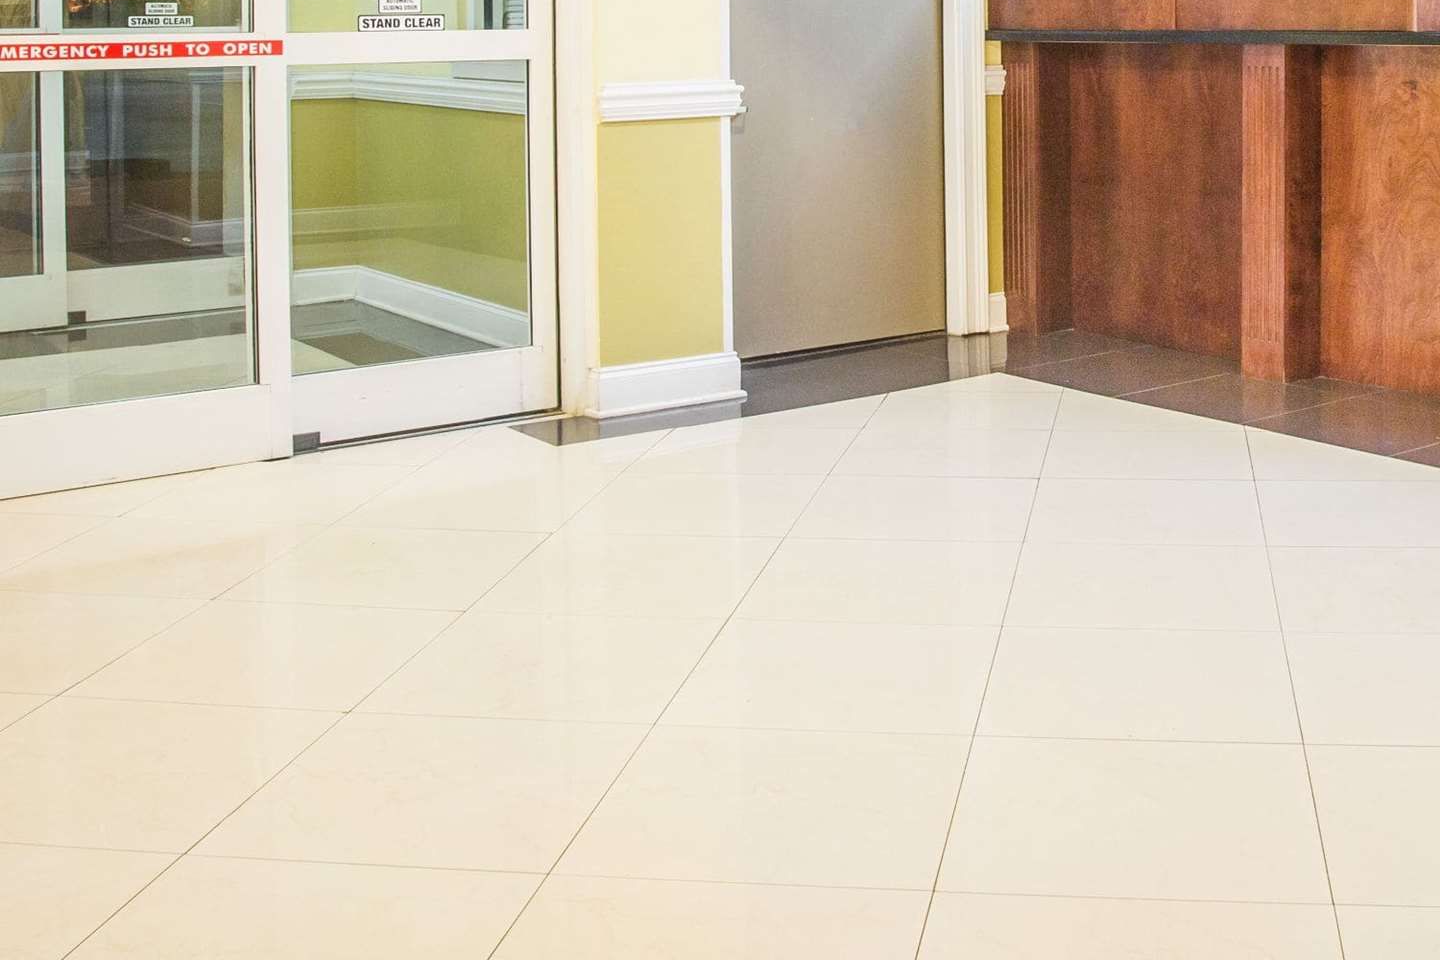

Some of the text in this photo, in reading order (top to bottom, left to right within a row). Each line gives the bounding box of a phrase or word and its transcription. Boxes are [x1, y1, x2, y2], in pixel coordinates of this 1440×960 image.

[130, 17, 191, 25] STAND CLEAR
[362, 17, 441, 29] STAND CLEAR
[0, 42, 273, 60] MERGENCY PUSH TO OPEN
